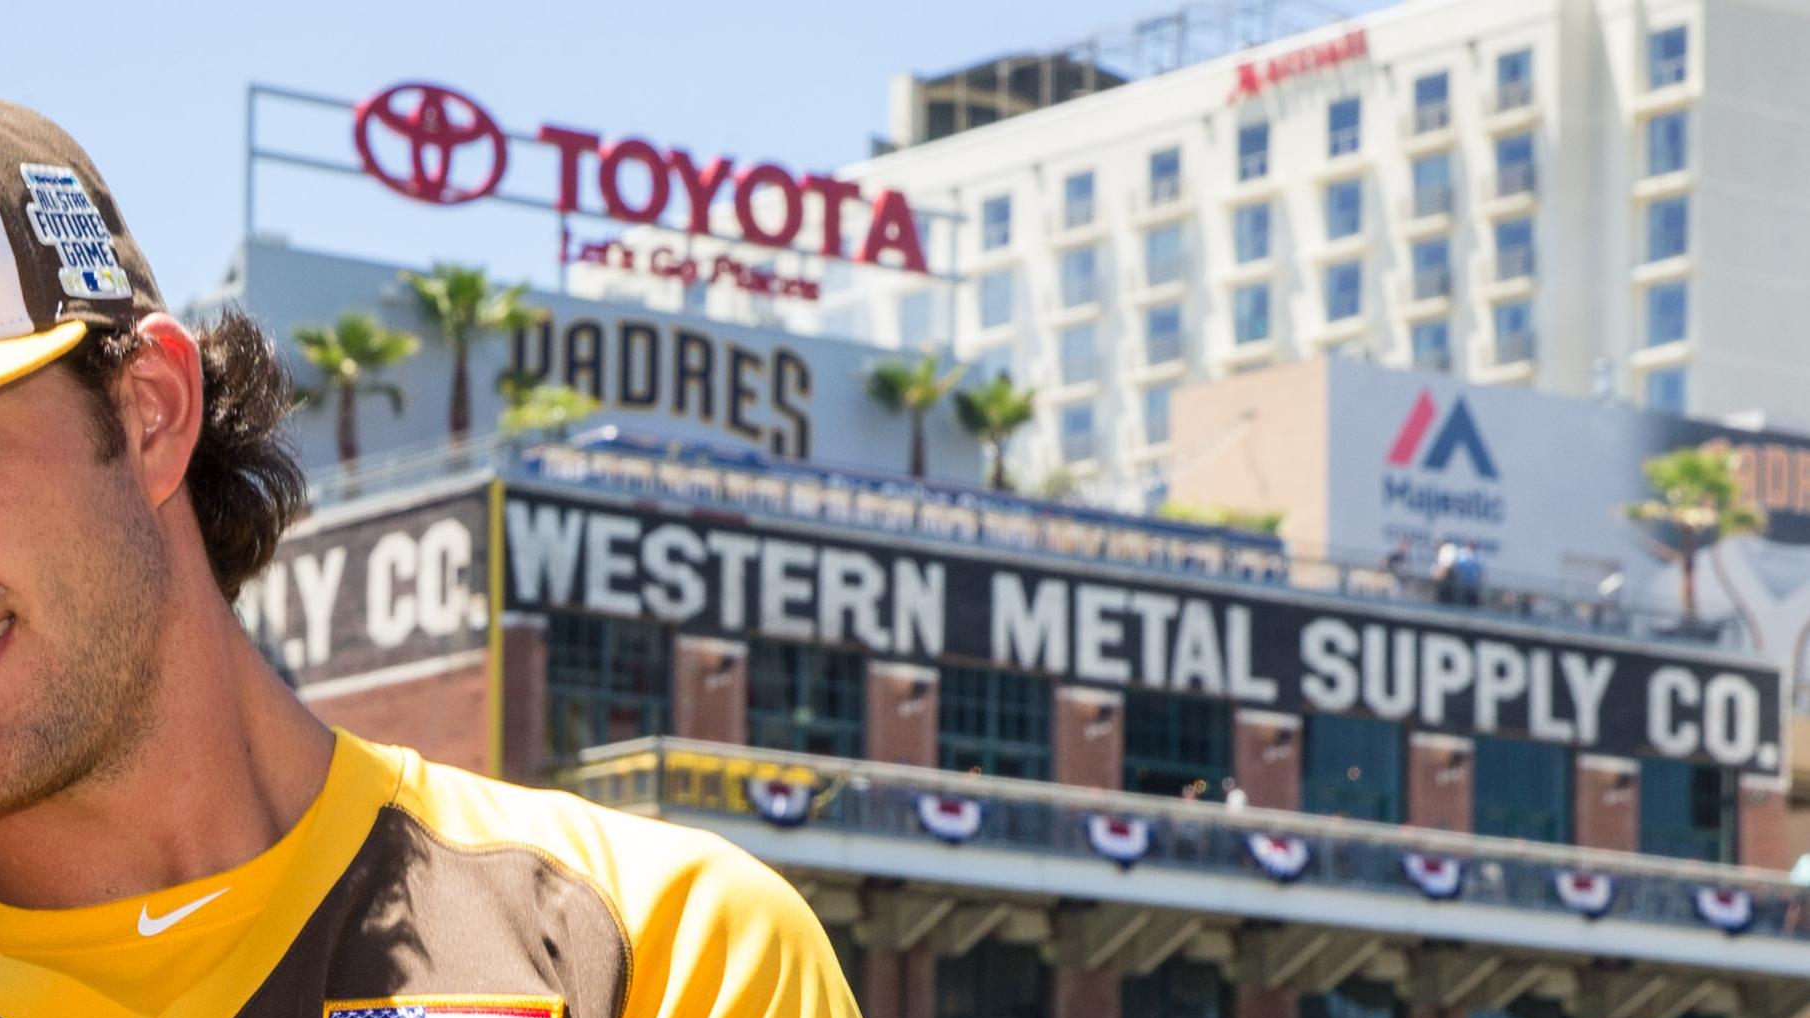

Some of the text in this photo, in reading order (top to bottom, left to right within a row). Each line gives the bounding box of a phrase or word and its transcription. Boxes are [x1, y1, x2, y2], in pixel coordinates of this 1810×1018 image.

[60, 241, 115, 268] GAME
[537, 122, 929, 275] TOYOTA
[1381, 474, 1506, 525] Majestic
[365, 517, 489, 650] CO.
[504, 502, 1780, 772] WESTERN METAL SUPPLY CO.
